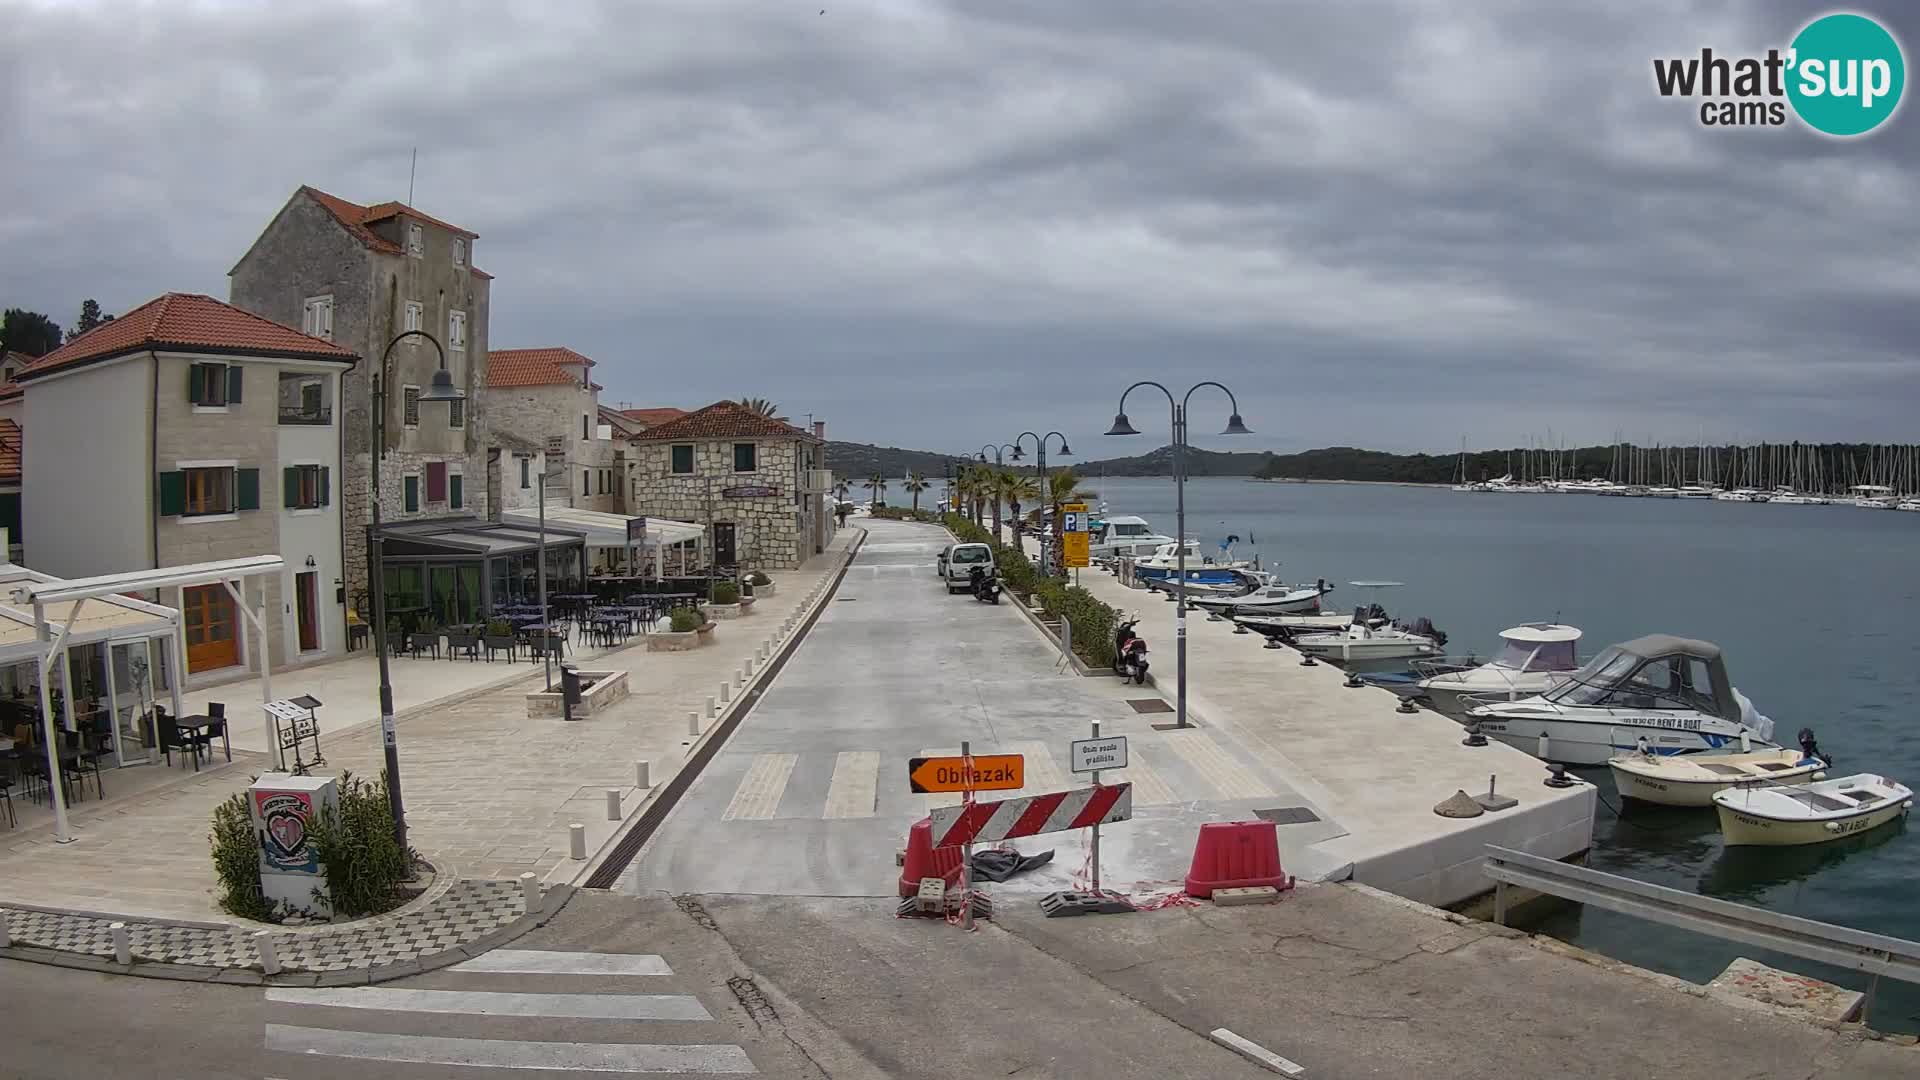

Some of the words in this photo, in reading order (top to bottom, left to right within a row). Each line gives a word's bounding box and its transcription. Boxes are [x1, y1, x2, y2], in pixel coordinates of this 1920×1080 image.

[1065, 514, 1075, 530] P
[1656, 718, 1677, 729] RENT
[1677, 718, 1682, 729] A
[1683, 719, 1702, 731] BOAT
[936, 763, 1015, 784] Obilazak
